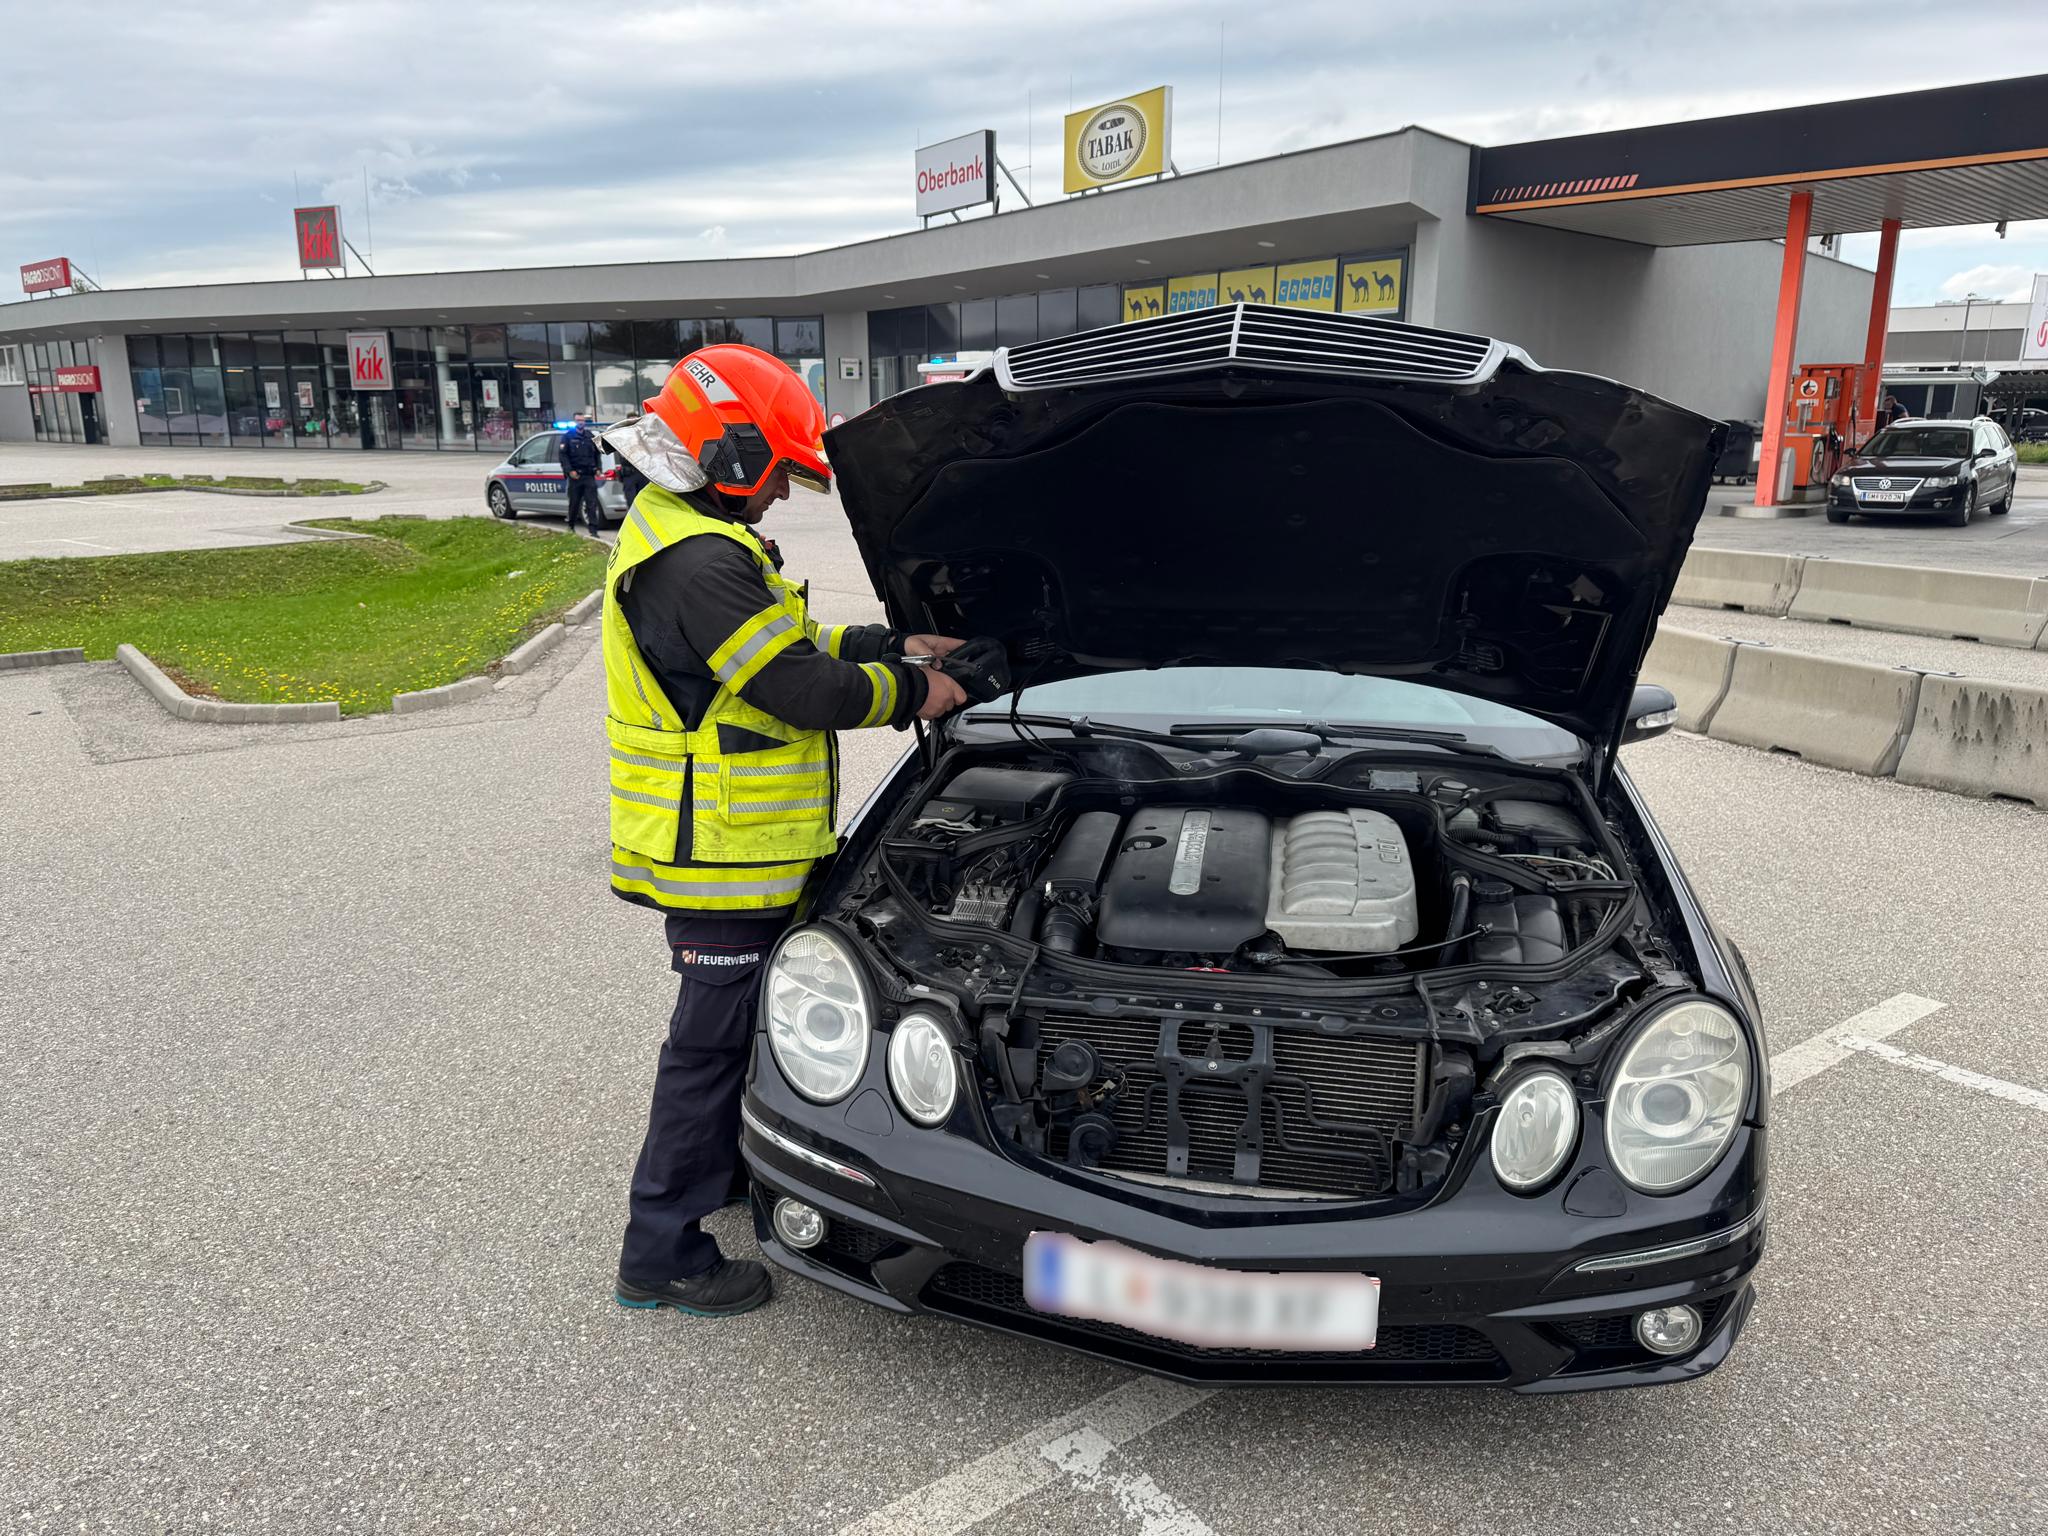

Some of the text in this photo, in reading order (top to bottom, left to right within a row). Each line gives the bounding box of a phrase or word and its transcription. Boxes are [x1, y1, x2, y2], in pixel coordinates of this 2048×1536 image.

[1088, 129, 1133, 160] TABAK
[917, 154, 983, 194] Oberbank
[1170, 288, 1216, 311] CAMEL
[1278, 276, 1334, 301] CAMEL
[525, 482, 557, 493] POLIZEI
[697, 953, 760, 966] FEUERWEHR
